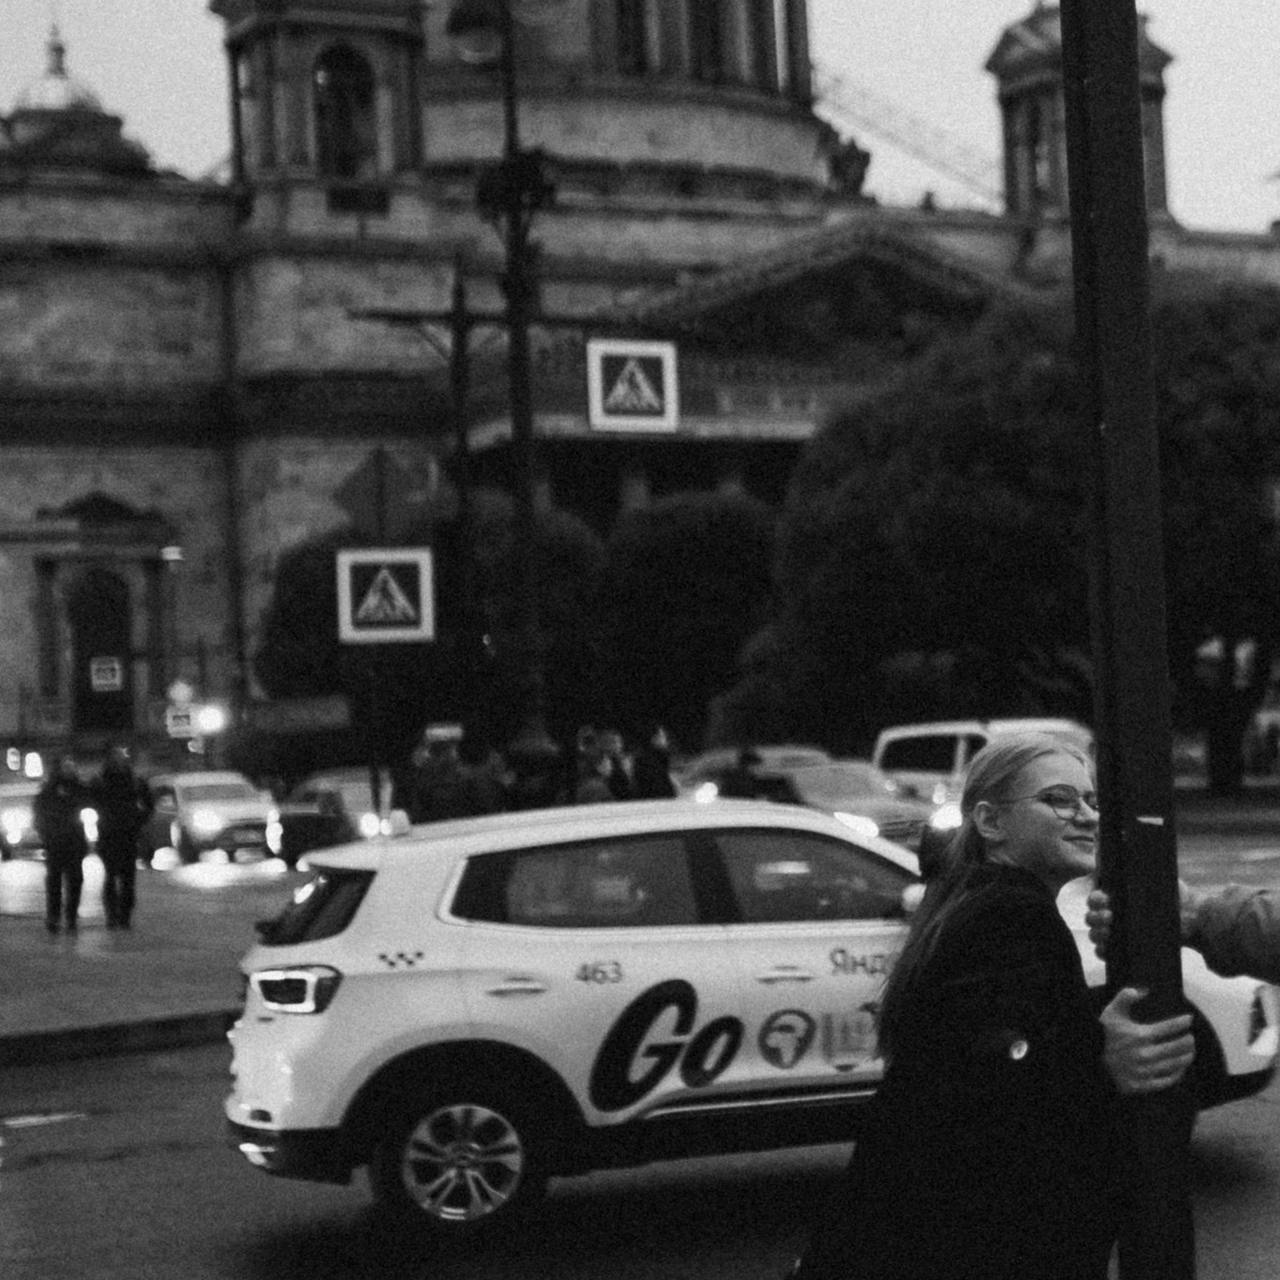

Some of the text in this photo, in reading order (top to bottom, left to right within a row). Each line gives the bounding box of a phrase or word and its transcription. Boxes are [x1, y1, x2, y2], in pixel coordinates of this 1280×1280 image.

[574, 961, 623, 984] 463
[829, 947, 893, 976] Янд
[588, 978, 745, 1113] Go
